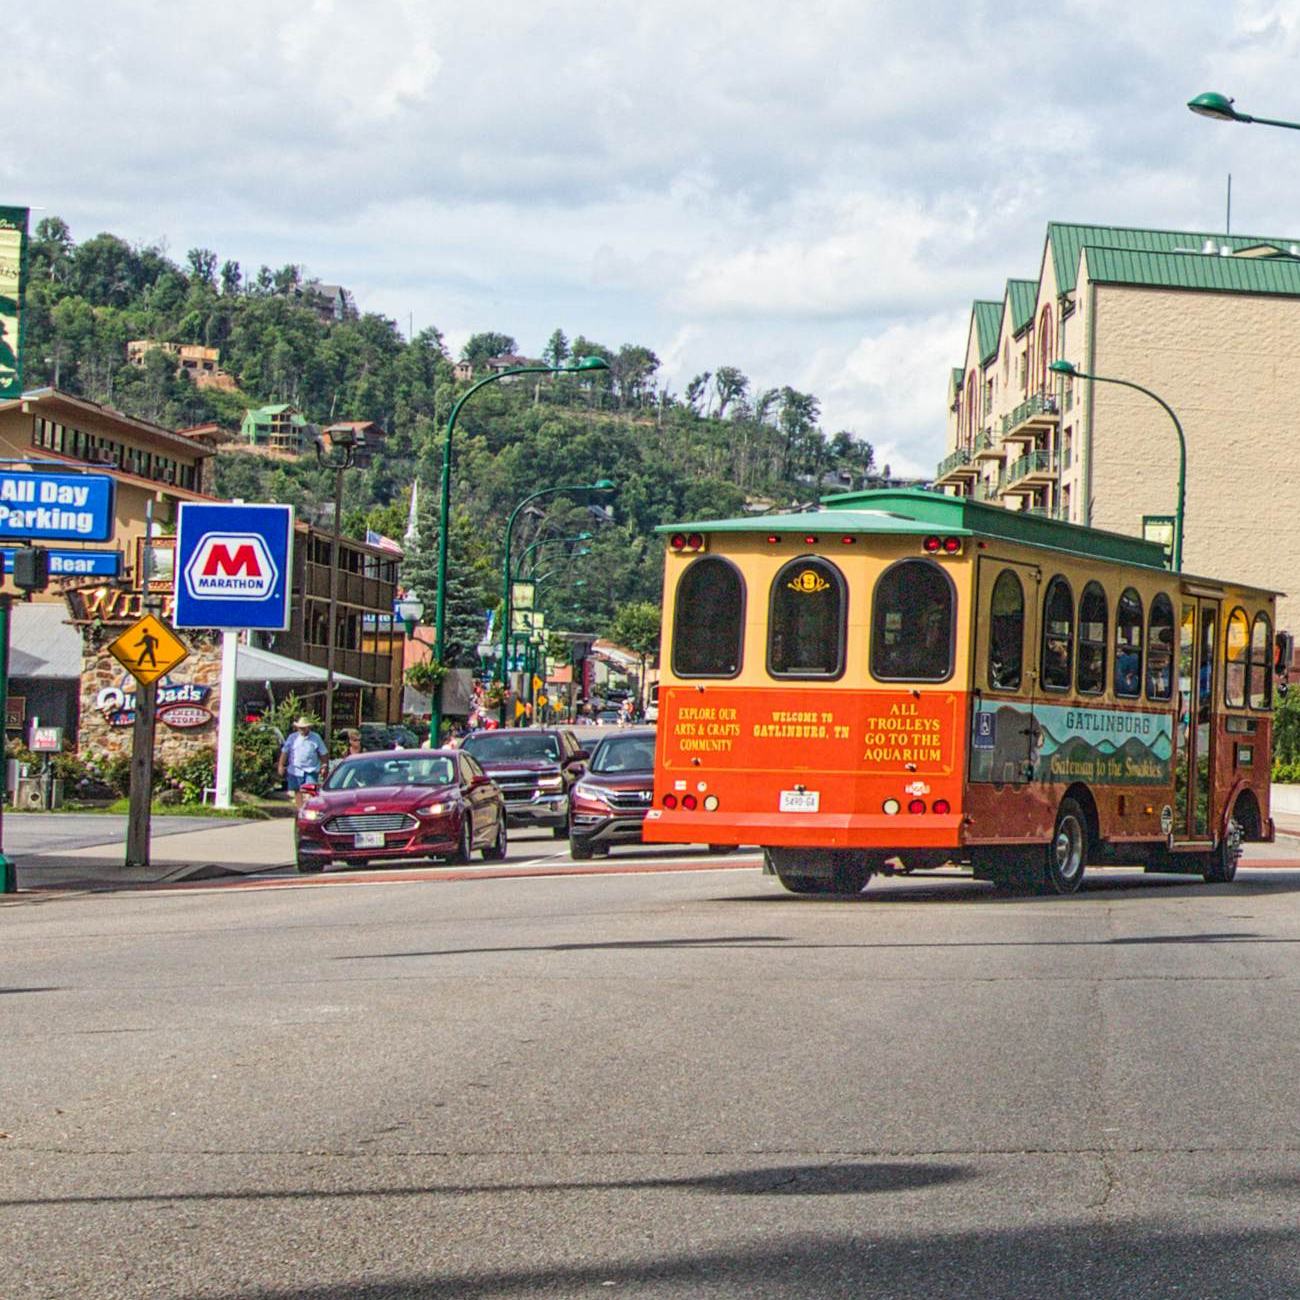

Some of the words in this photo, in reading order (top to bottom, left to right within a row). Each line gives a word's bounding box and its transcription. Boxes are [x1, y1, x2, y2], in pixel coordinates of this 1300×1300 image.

[1, 479, 35, 502] All
[40, 481, 89, 507] Day
[0, 505, 93, 533] Parking
[50, 557, 95, 572] Rear
[202, 544, 262, 576] M
[199, 579, 264, 589] MARATHON
[678, 707, 716, 720] EXPLORE
[719, 708, 736, 720] OUR
[889, 703, 919, 715] ALL
[772, 711, 817, 722] WELCOME
[821, 712, 833, 723] TO
[867, 717, 940, 731] TROLLEYS
[1066, 711, 1150, 734] GATLINBURG
[674, 723, 696, 735] ARTS
[698, 724, 705, 735] &
[707, 723, 740, 736] CRAFTS
[753, 724, 829, 739] GATLINBURG,
[834, 725, 849, 738] TN
[680, 738, 732, 751] COMMUNITY
[865, 732, 885, 745] GO
[888, 733, 908, 745] TO
[911, 734, 940, 746] THE
[863, 748, 941, 762] AQUARIUM
[1050, 753, 1094, 780] Gateway
[1096, 757, 1106, 777] to
[1108, 757, 1122, 776] the
[1125, 757, 1164, 778] Smokies
